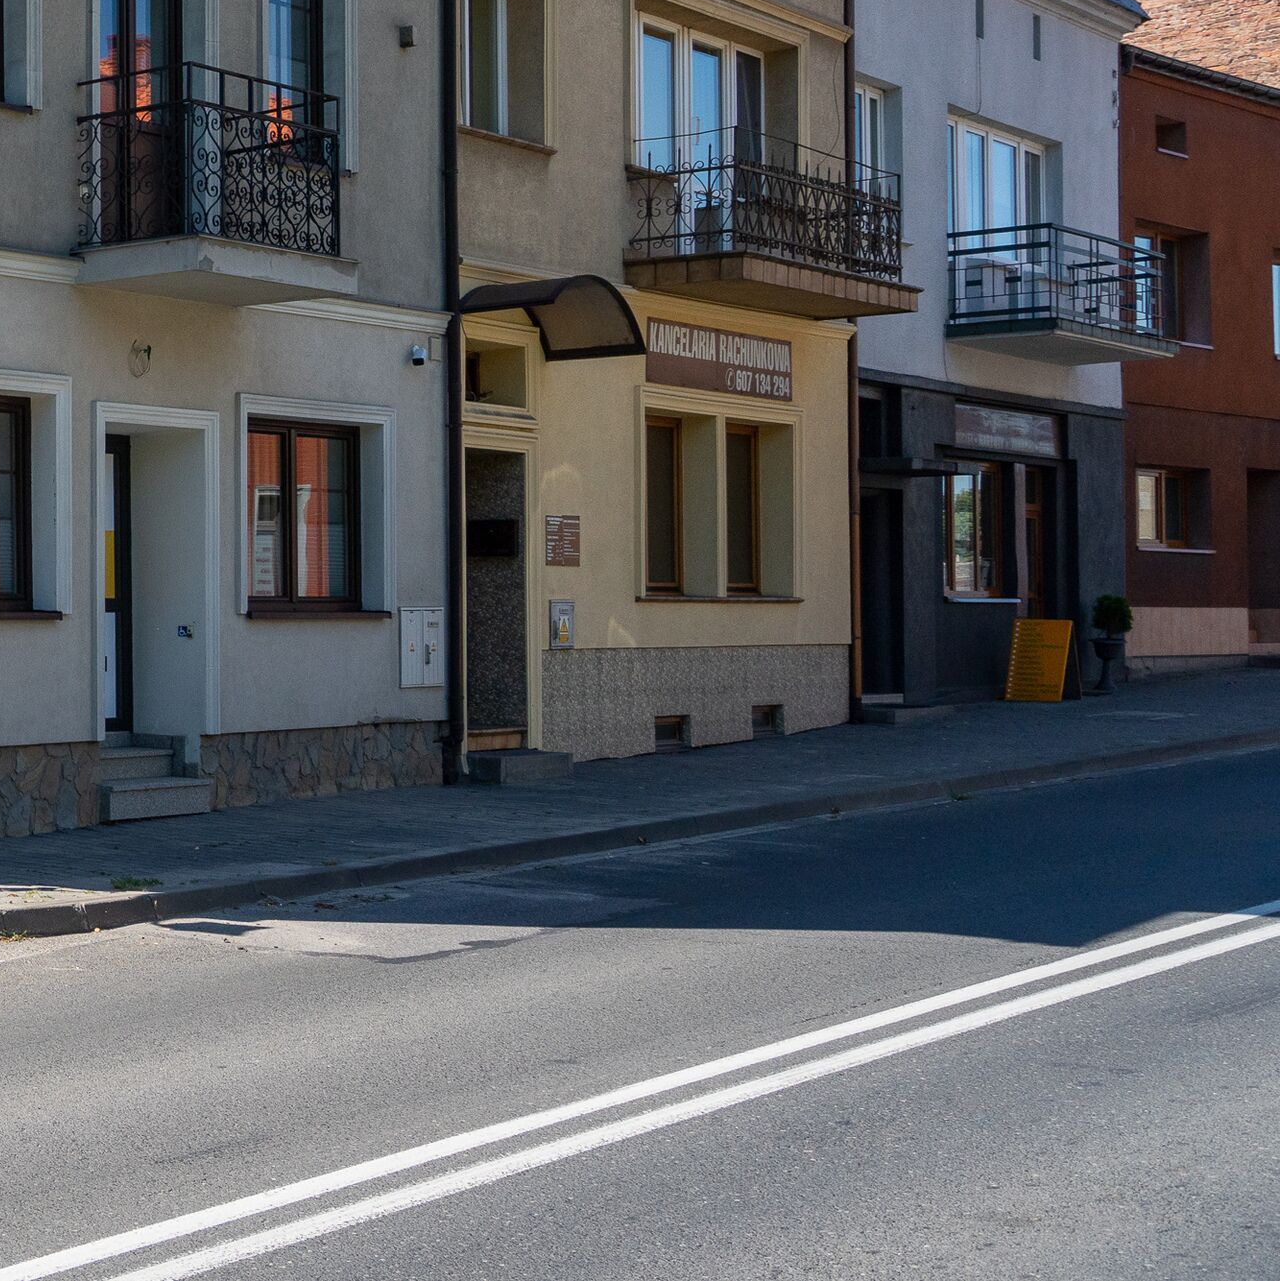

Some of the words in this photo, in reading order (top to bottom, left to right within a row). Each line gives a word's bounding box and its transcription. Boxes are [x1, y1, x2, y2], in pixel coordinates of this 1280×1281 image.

[649, 322, 717, 361] KANCELARIA
[719, 334, 791, 373] RACHUNKOWA
[735, 370, 753, 392] 607
[755, 373, 771, 395] 134
[773, 376, 790, 397] 294
